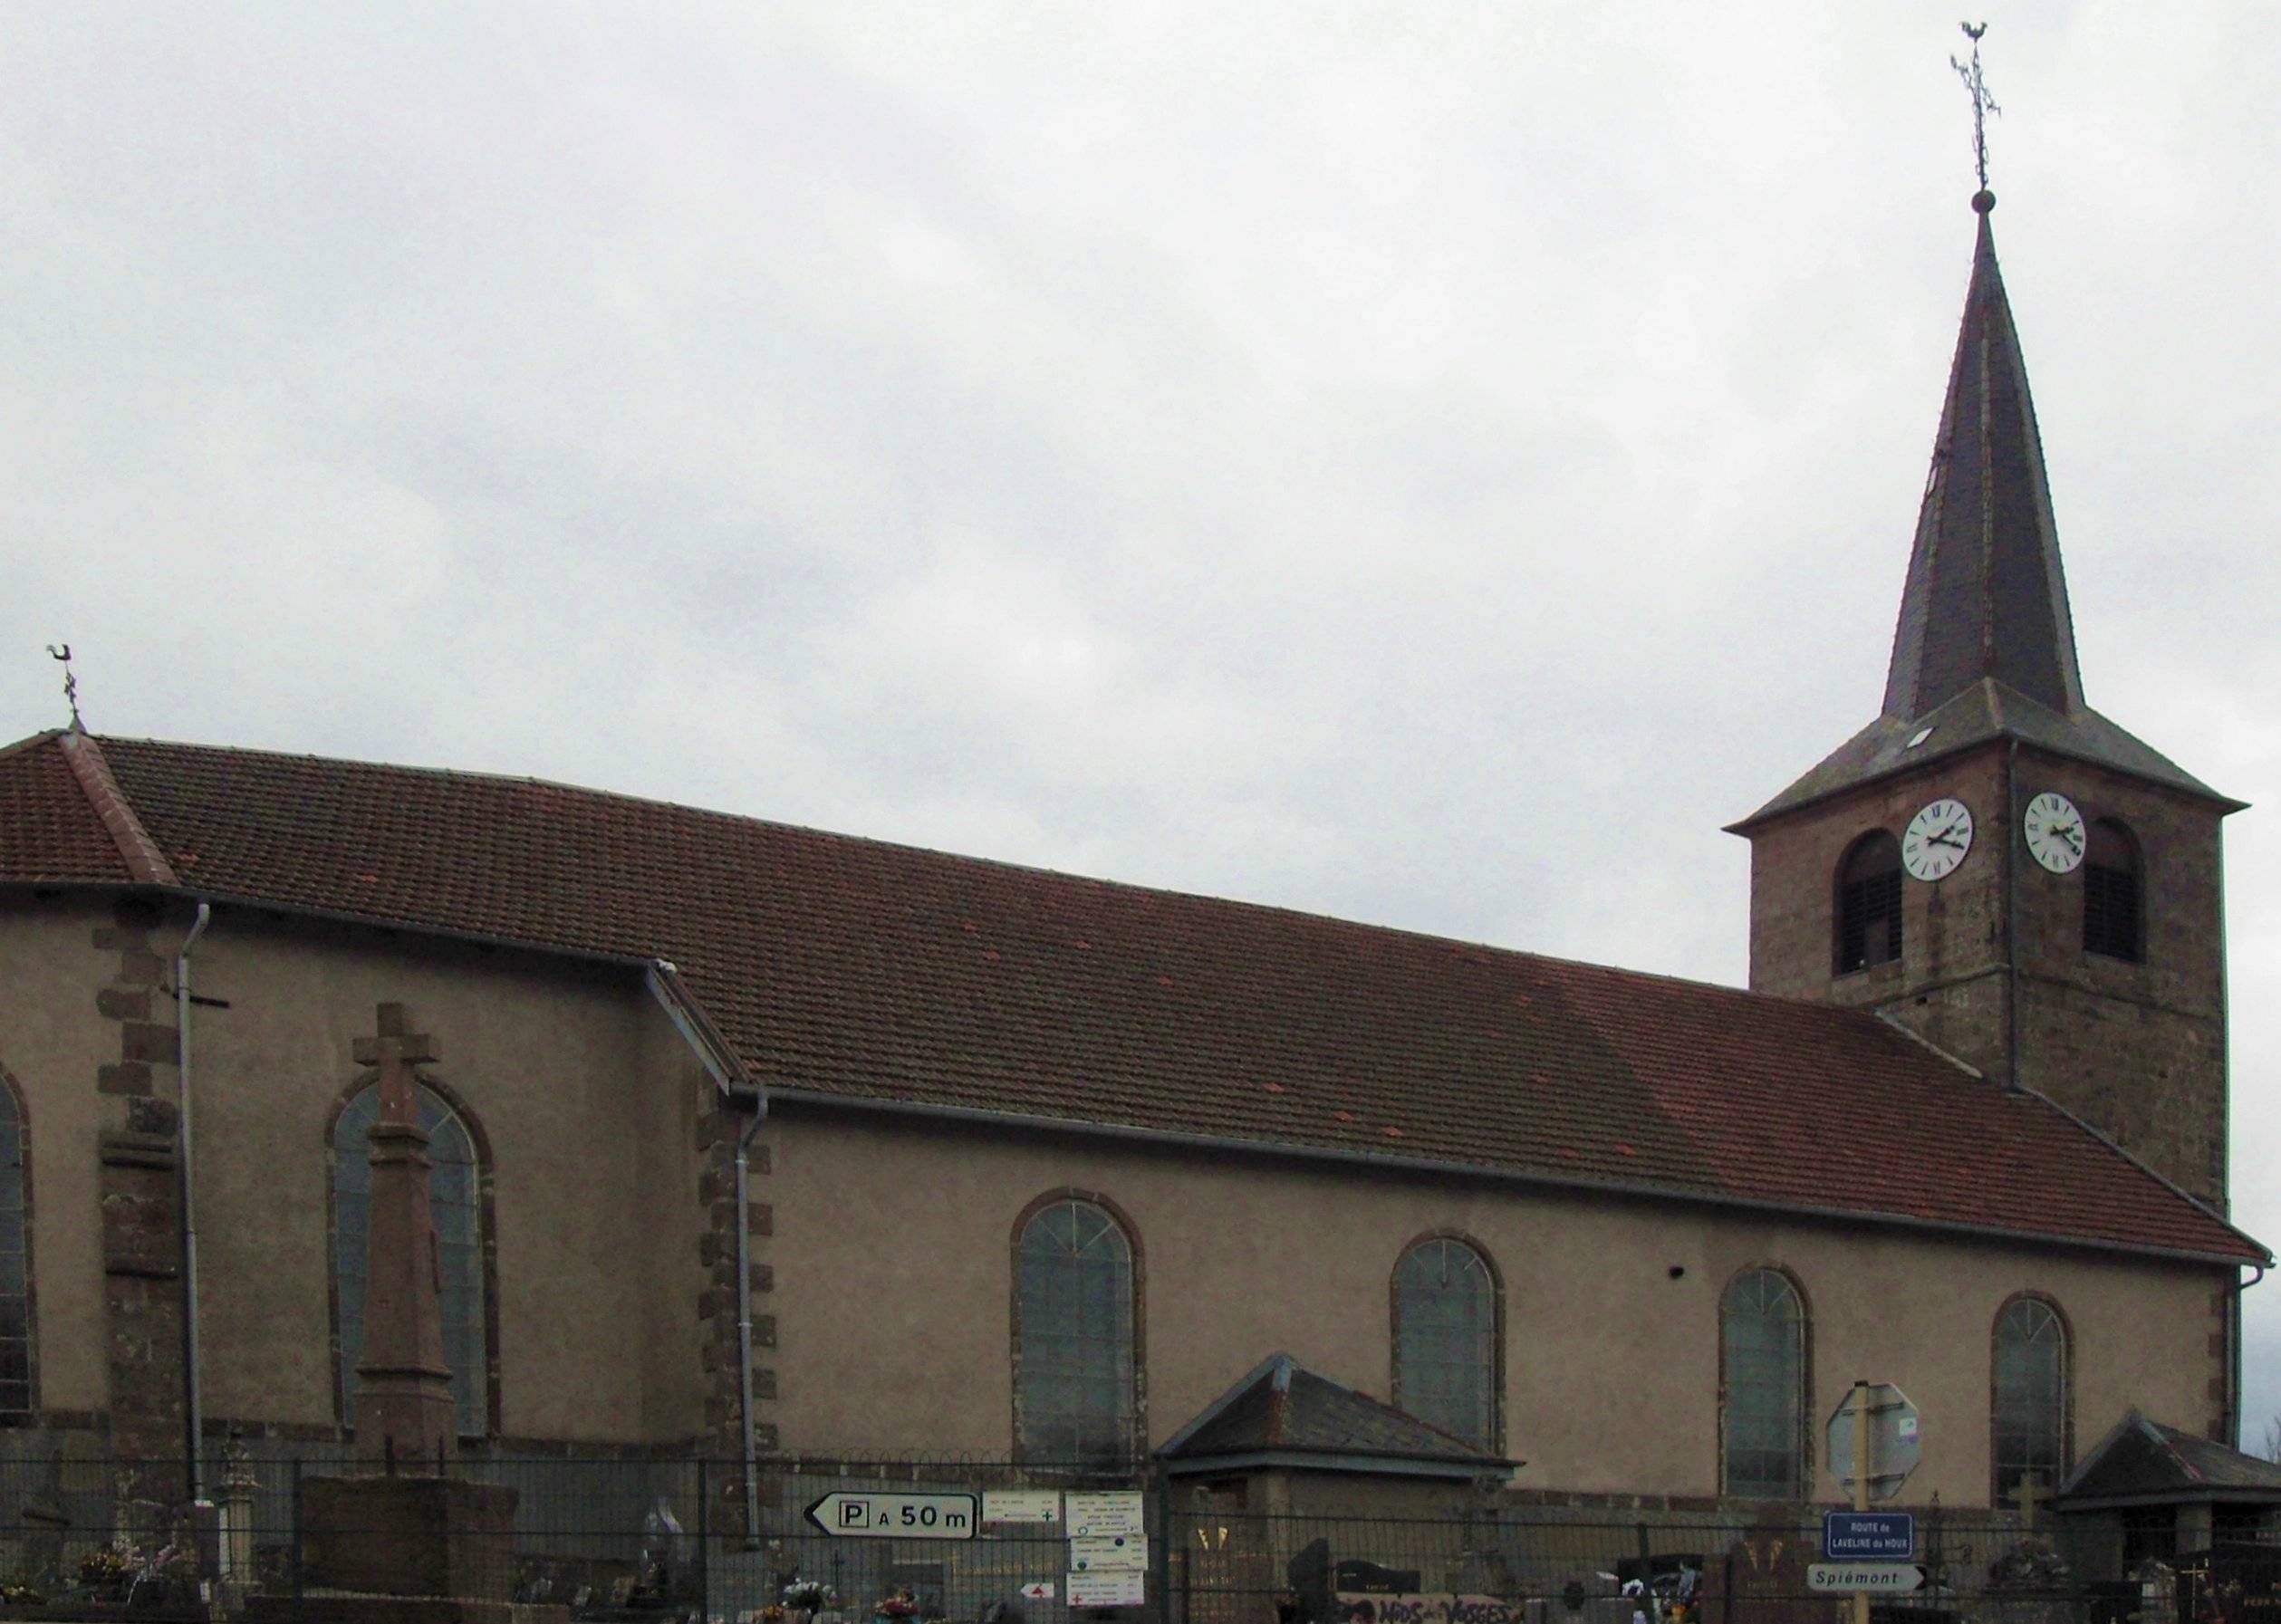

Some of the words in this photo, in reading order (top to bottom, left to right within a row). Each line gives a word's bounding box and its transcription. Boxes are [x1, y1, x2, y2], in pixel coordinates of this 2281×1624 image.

[845, 1504, 862, 1524] P
[879, 1512, 890, 1525] A
[901, 1505, 938, 1526] 50
[946, 1513, 966, 1528] m
[1851, 1522, 1878, 1533] ROUTE
[1880, 1522, 1890, 1533] de
[1832, 1538, 1871, 1548] LAVELINE
[1815, 1570, 1900, 1586] Spiémont
